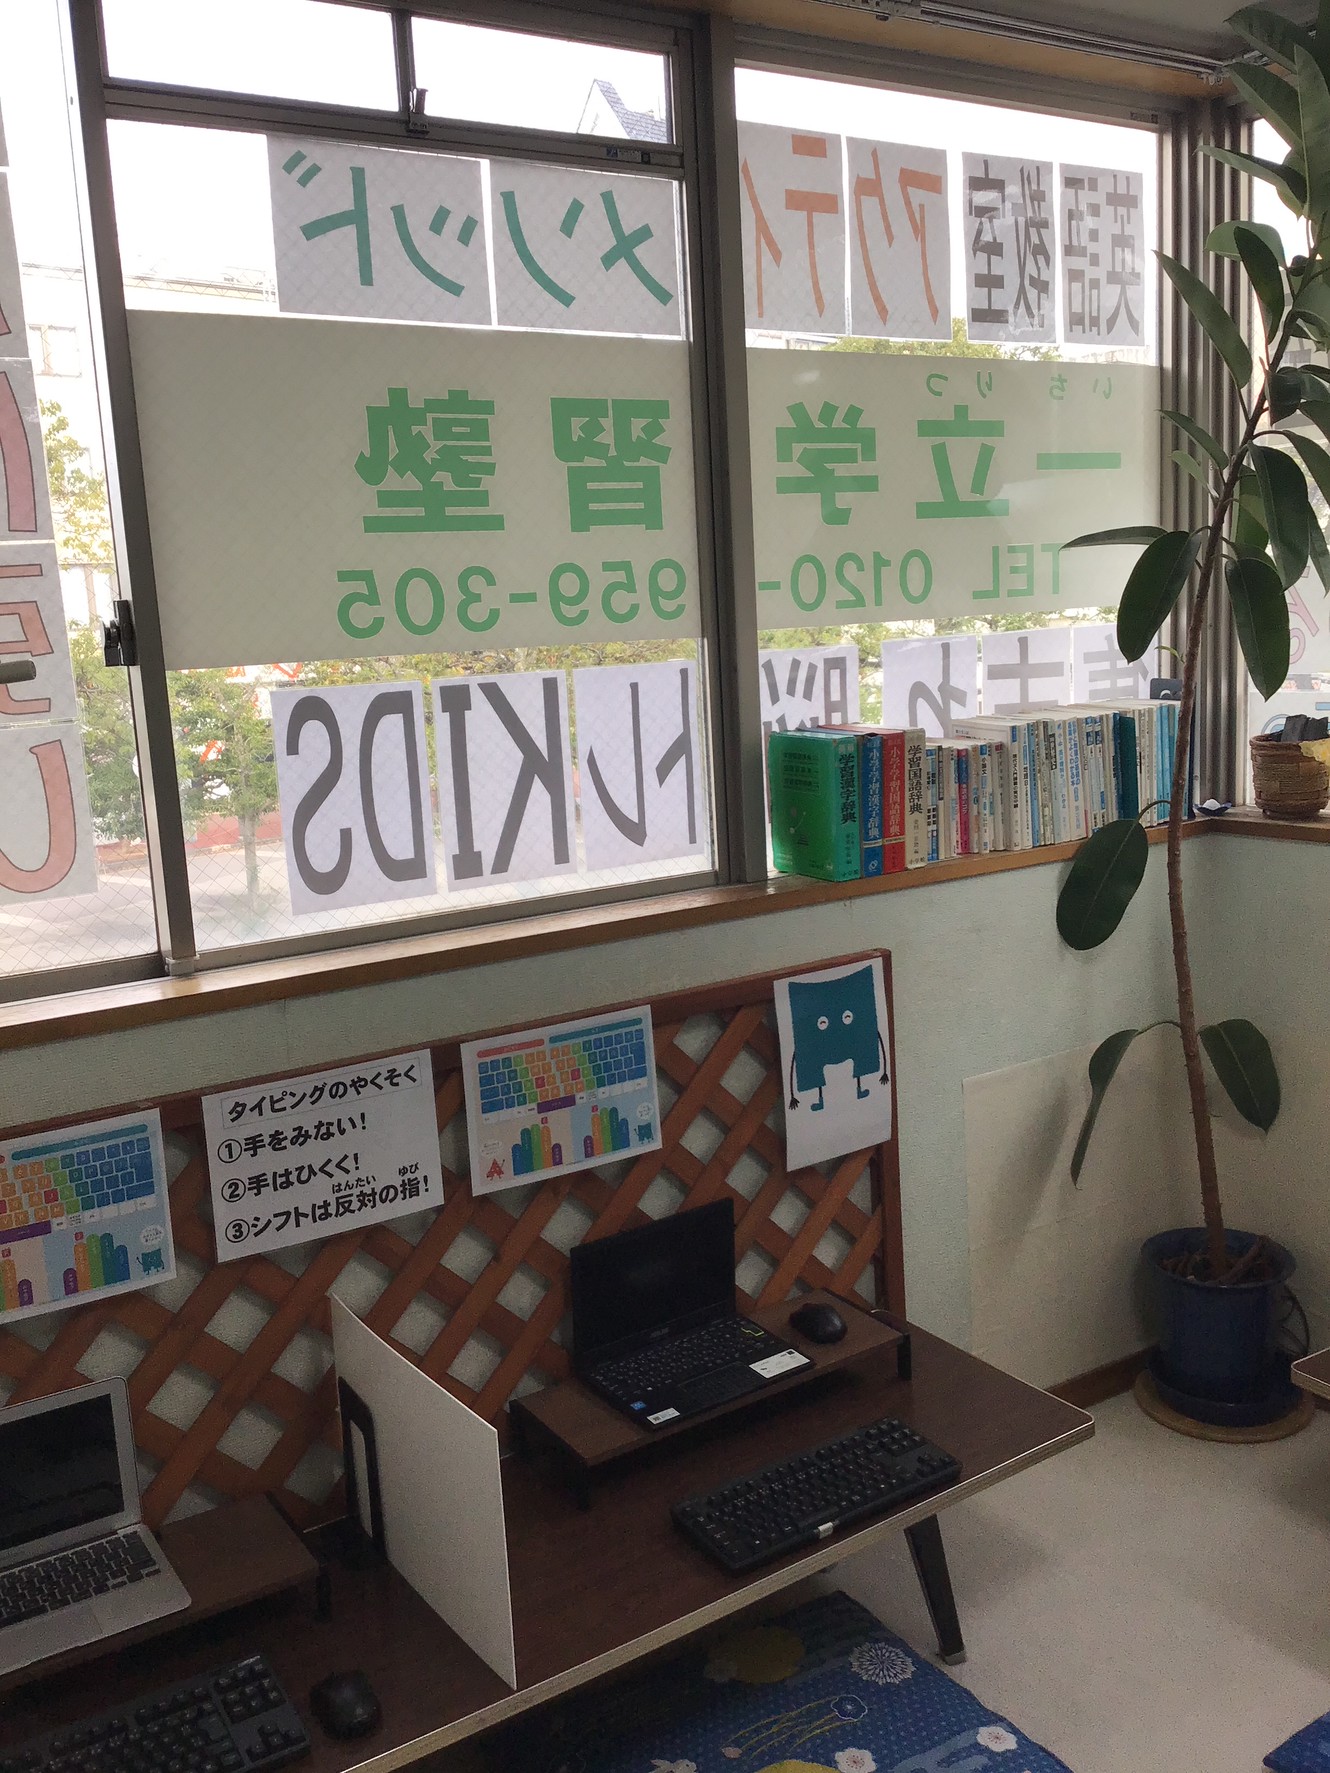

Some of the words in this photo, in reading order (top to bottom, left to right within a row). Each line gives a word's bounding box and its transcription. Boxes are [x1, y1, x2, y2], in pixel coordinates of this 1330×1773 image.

[907, 744, 924, 815] 学習国語辞典
[227, 1063, 418, 1123] タイピングのやくそく
[331, 1174, 377, 1195] はんたい
[397, 1161, 420, 1178] ゆび
